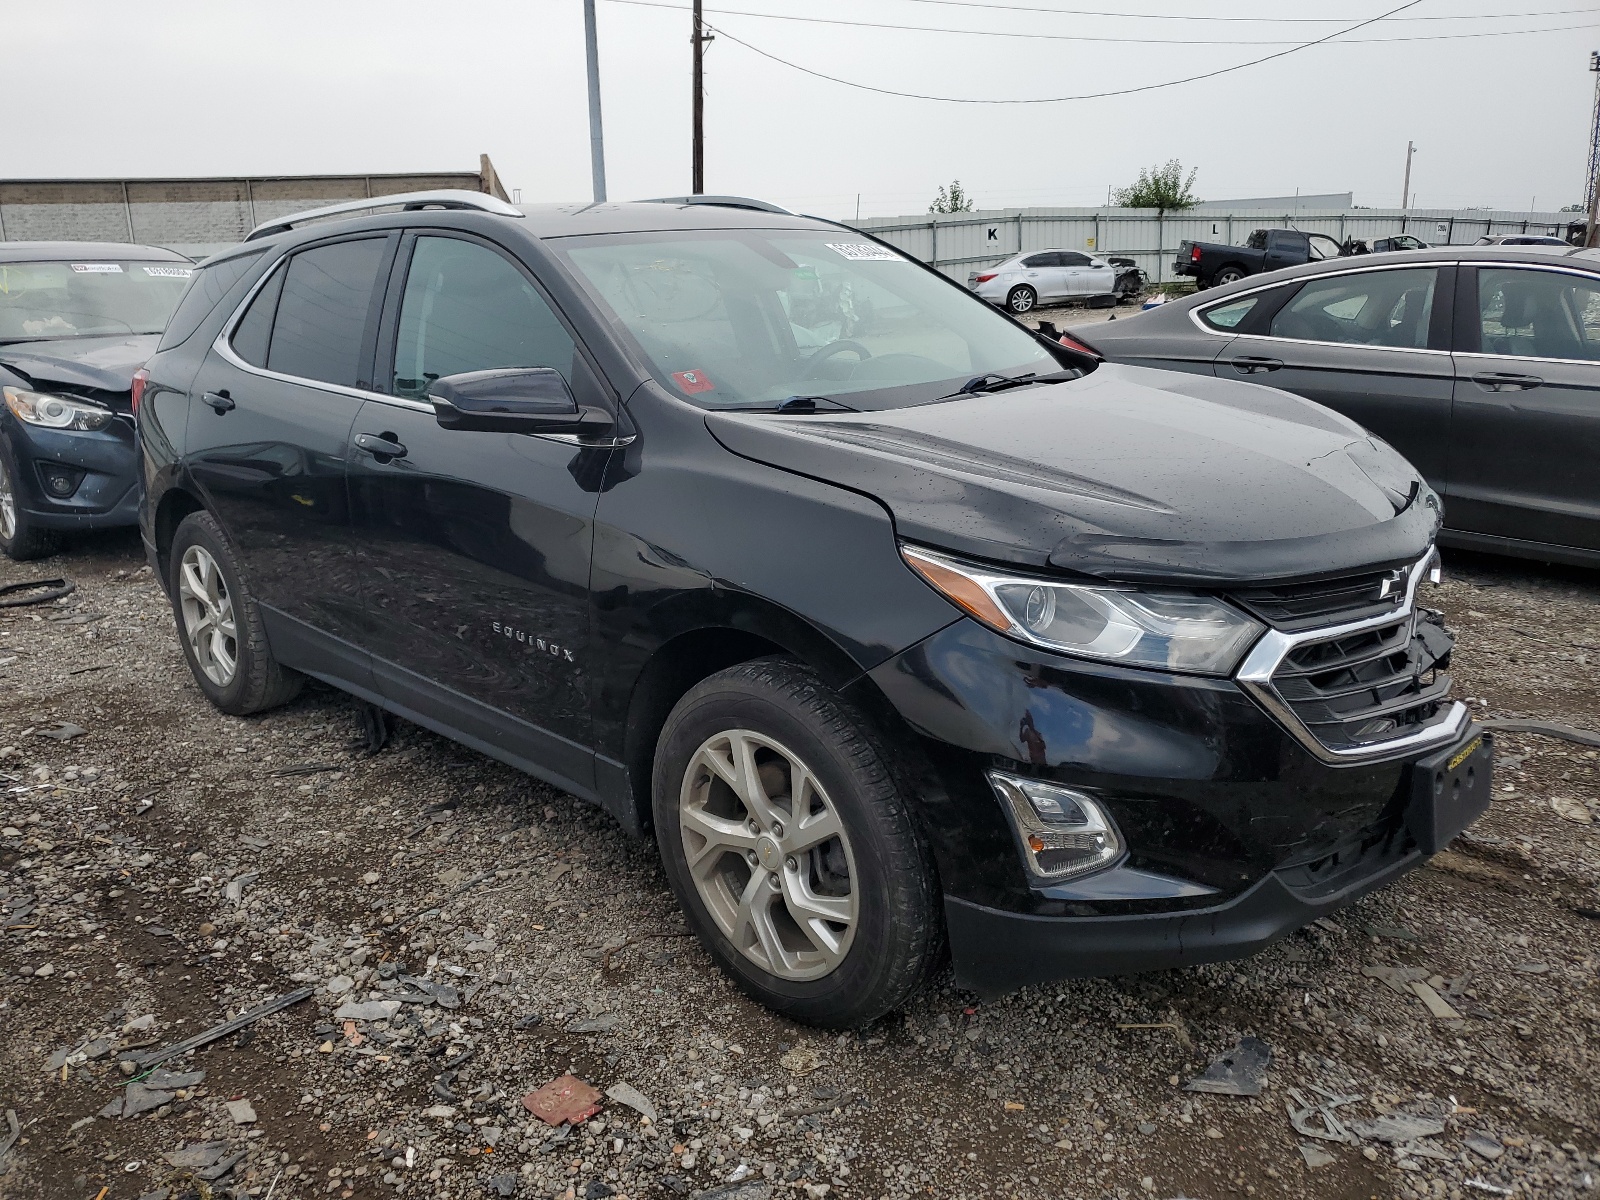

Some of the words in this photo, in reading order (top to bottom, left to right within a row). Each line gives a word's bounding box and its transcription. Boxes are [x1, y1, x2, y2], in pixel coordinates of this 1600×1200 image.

[987, 228, 998, 241] K
[1212, 223, 1219, 235] L
[492, 621, 575, 663] EQUINOX
